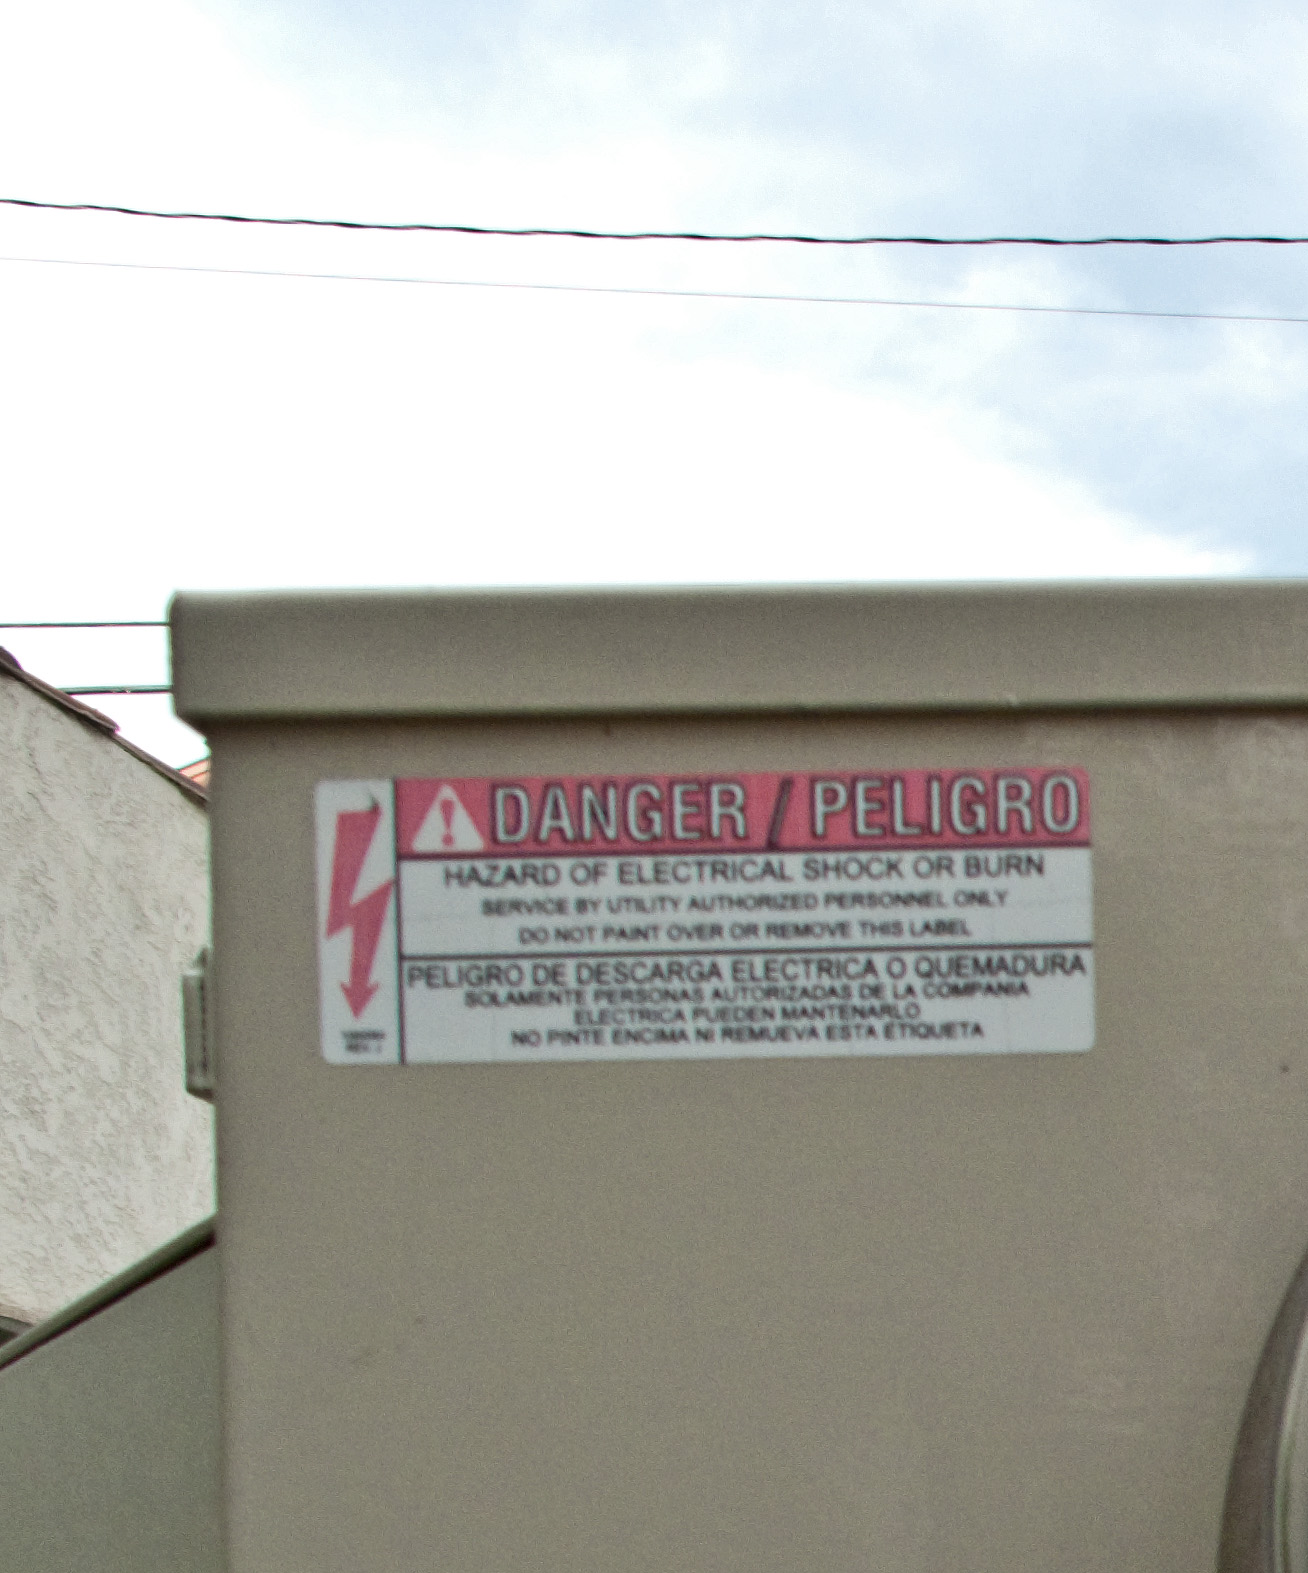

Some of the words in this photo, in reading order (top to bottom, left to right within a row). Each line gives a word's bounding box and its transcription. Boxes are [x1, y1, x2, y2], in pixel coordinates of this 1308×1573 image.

[492, 779, 748, 844] DANGER
[765, 777, 793, 848] /
[810, 774, 1080, 839] PELIGRO
[443, 861, 561, 887] HAZARD
[570, 861, 607, 885] OF
[617, 857, 793, 884] ELECTRICAL
[803, 855, 903, 881] SHOCK
[912, 854, 954, 879] OR
[964, 852, 1044, 878] BURN
[482, 898, 569, 916] SERVICE
[574, 897, 600, 915] BY
[606, 896, 680, 914] UTILITY
[687, 893, 817, 913] AUTHORIZED
[823, 890, 948, 910] PERSONNEL
[953, 889, 1009, 908] ONLY
[518, 926, 548, 944] DO
[554, 925, 598, 943] NOT
[604, 924, 661, 942] PAINT
[667, 923, 724, 941] OVER
[730, 922, 759, 940] OR
[765, 920, 850, 939] REMOVE
[859, 919, 904, 937] THIS
[910, 918, 972, 937] LABEL
[407, 962, 524, 989] PELIGRO
[531, 962, 568, 987] DE
[576, 960, 723, 986] DESCARGA
[731, 956, 878, 983] ELECTRICA
[886, 956, 907, 980] O
[914, 952, 1086, 979] QUEMADURA
[464, 989, 584, 1007] SOLAMENTE
[594, 987, 705, 1004] PERSONAS
[711, 985, 851, 1002] AUTORIZADAS
[859, 983, 888, 1000] DE
[893, 982, 917, 998] LA
[573, 1007, 686, 1025] ELECTRICA
[692, 1004, 774, 1023] PUEDEN
[511, 1029, 541, 1046] NO
[547, 1028, 601, 1046] PINTE
[611, 1027, 688, 1045] ENCIMA
[695, 1026, 715, 1044] NI
[721, 1024, 818, 1043] REMUEVA
[826, 1023, 877, 1041] ESTA
